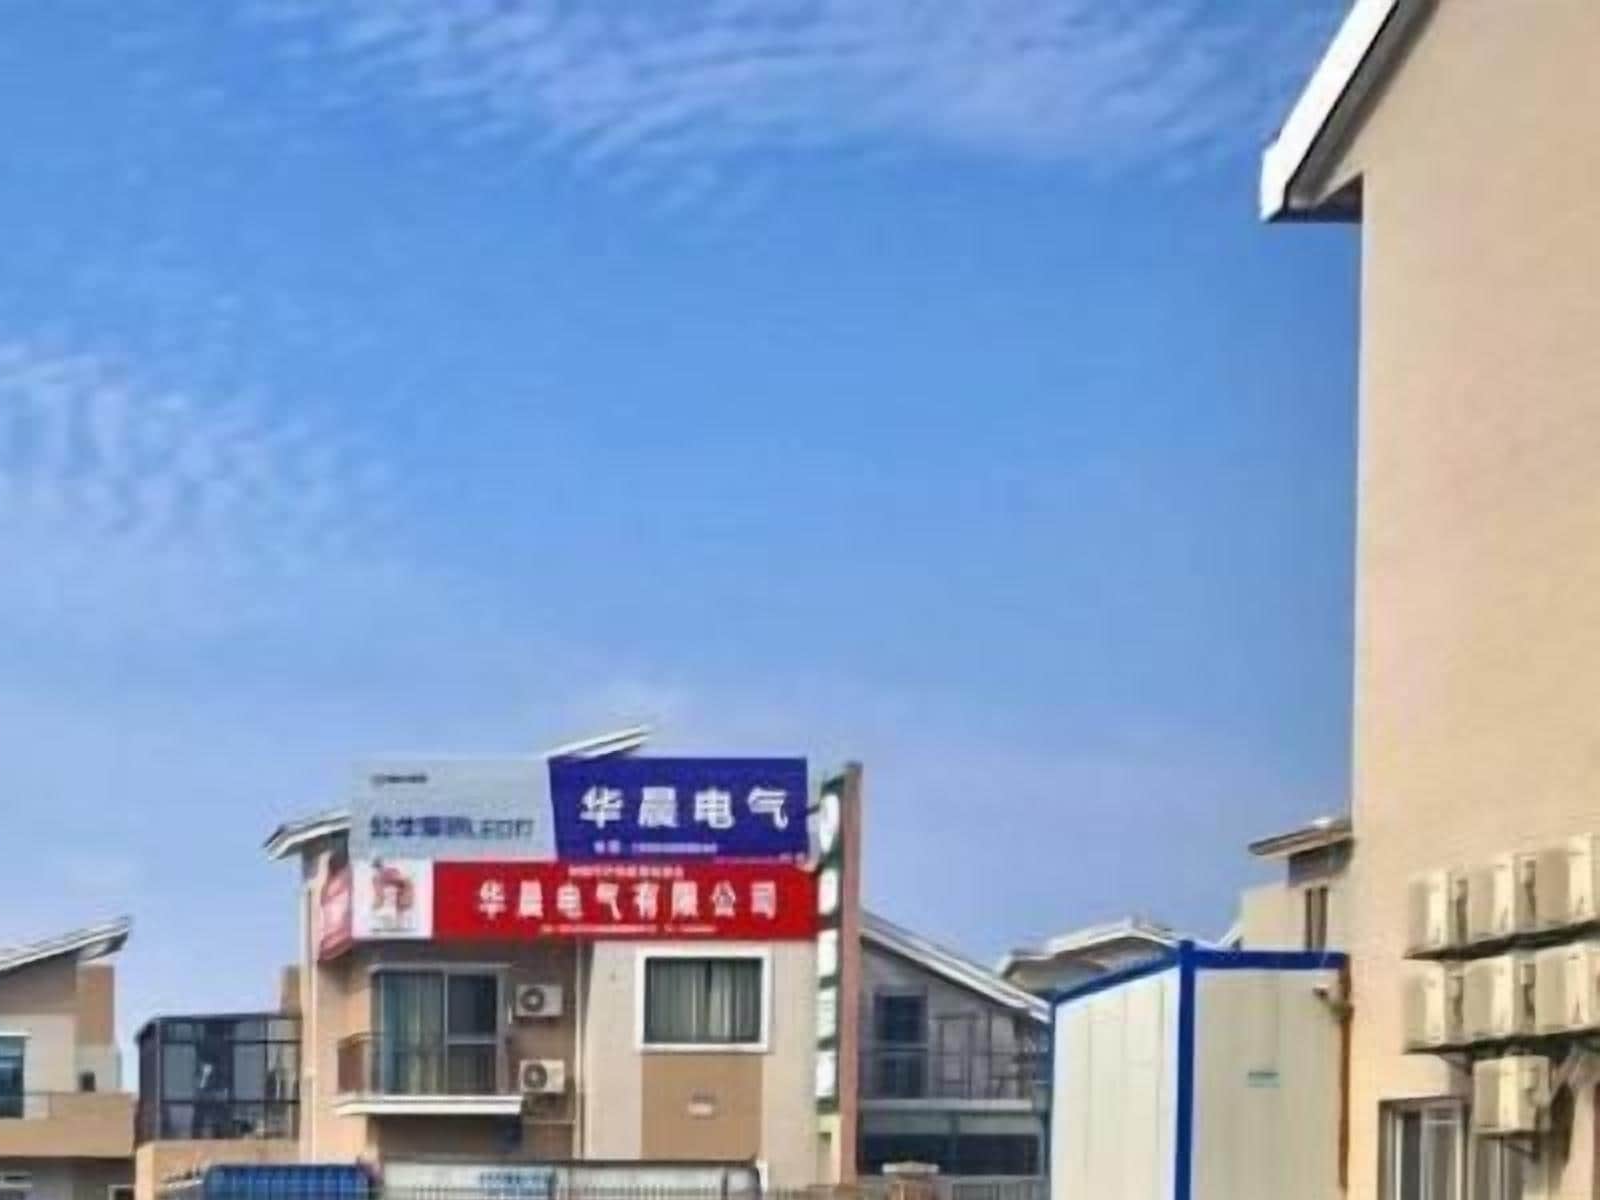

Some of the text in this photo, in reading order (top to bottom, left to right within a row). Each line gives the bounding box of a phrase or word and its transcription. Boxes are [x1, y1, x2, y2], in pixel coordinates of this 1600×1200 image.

[579, 784, 789, 829] 华晨电气
[477, 879, 777, 921] 华晨电气有限公司
